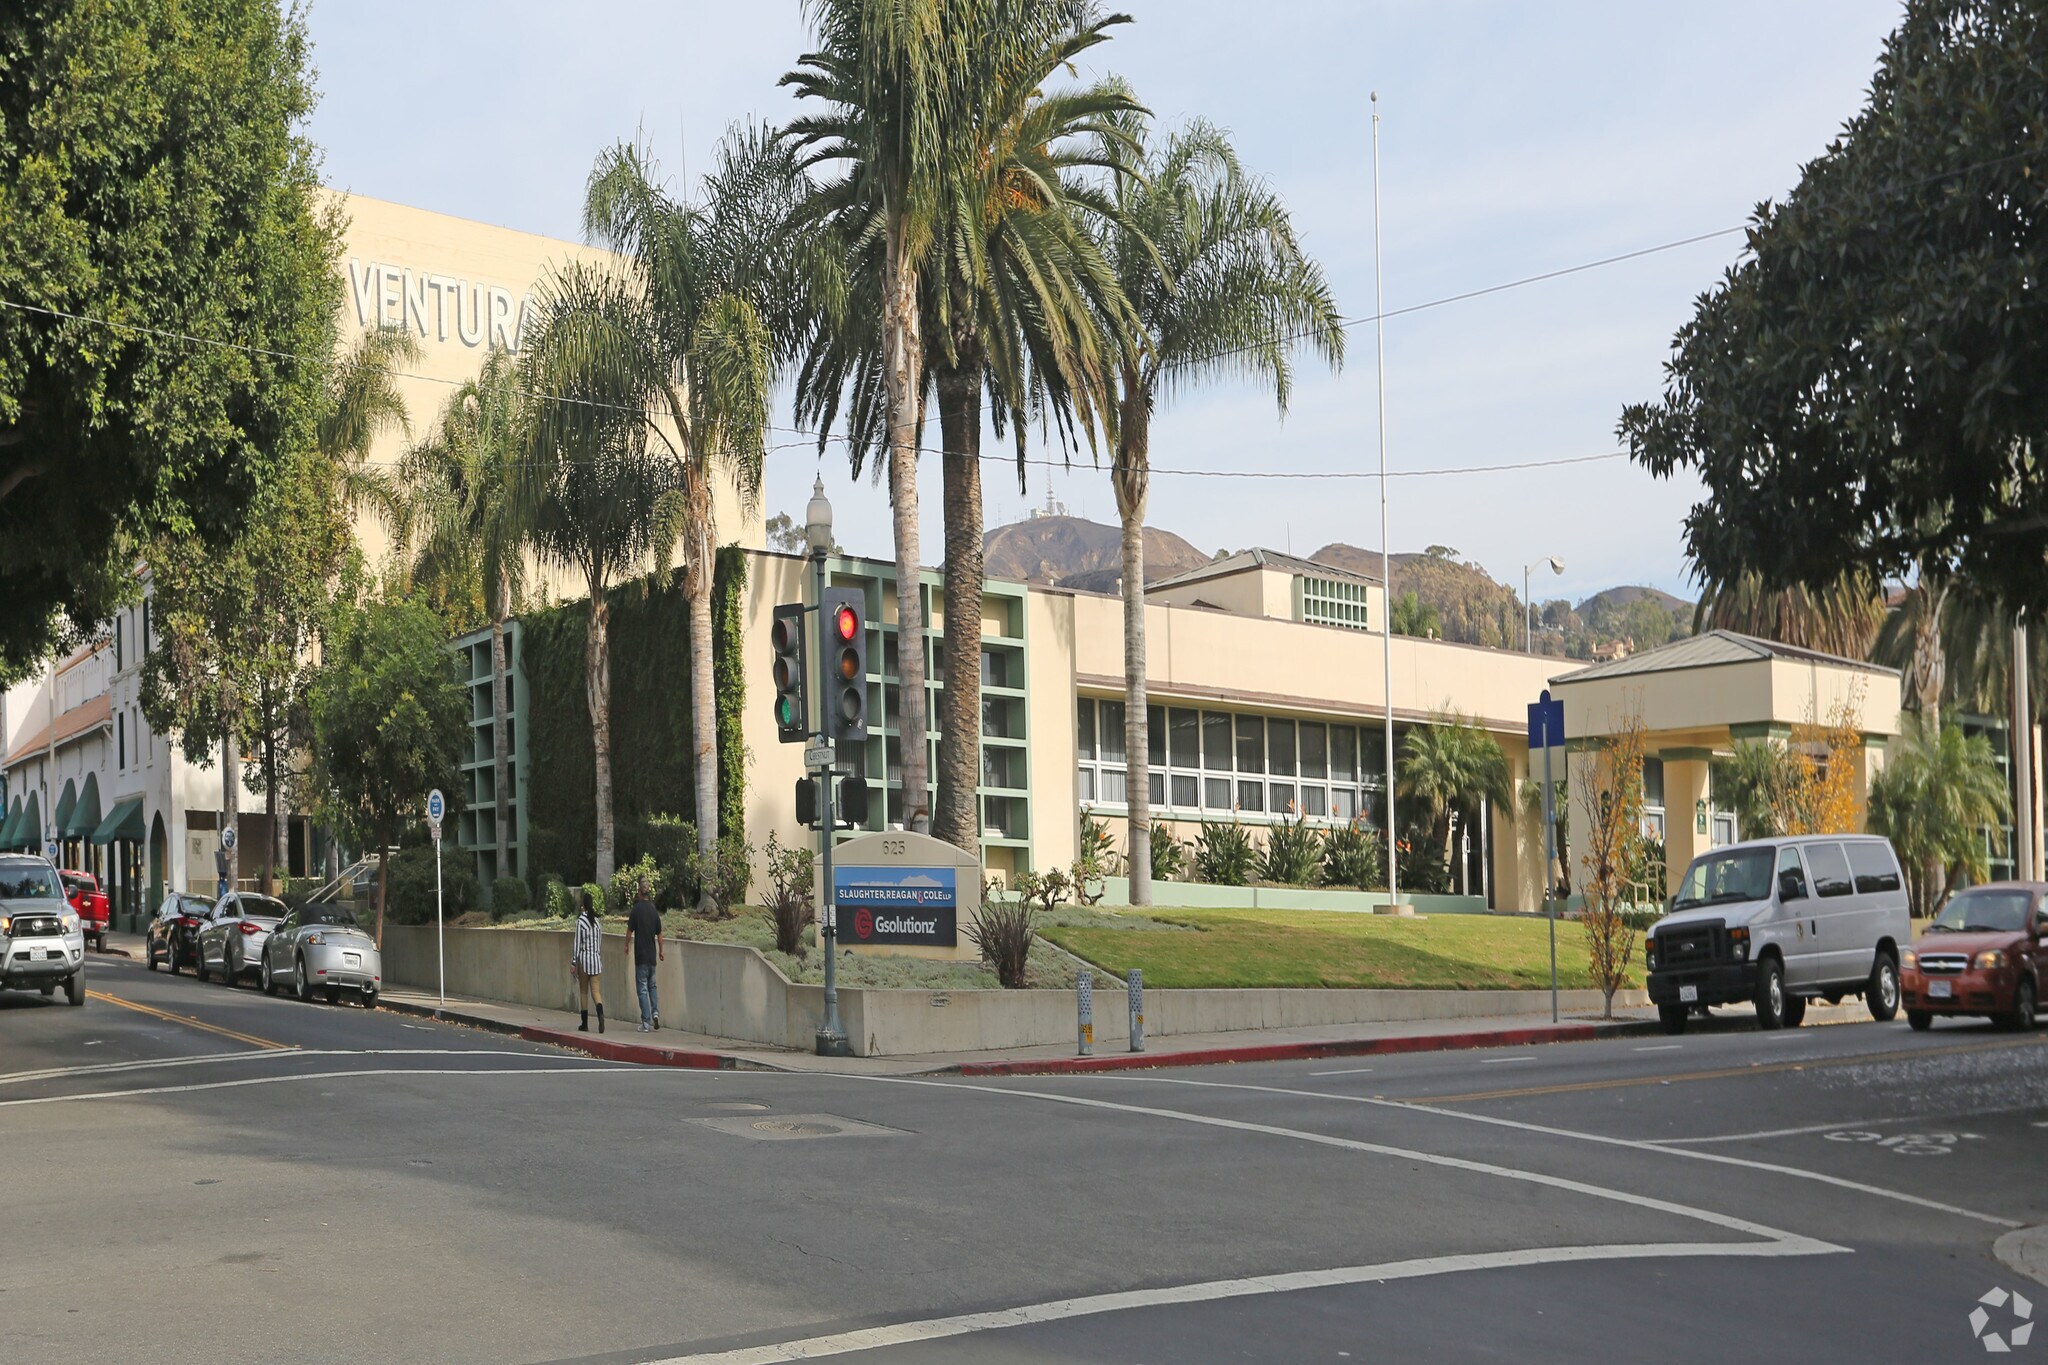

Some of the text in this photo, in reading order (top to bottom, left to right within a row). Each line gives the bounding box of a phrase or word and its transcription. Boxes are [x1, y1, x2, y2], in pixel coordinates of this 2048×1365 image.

[882, 840, 905, 855] 625
[886, 890, 917, 900] REAGAN
[923, 890, 943, 900] COLE
[875, 915, 936, 934] Gsolutionz
